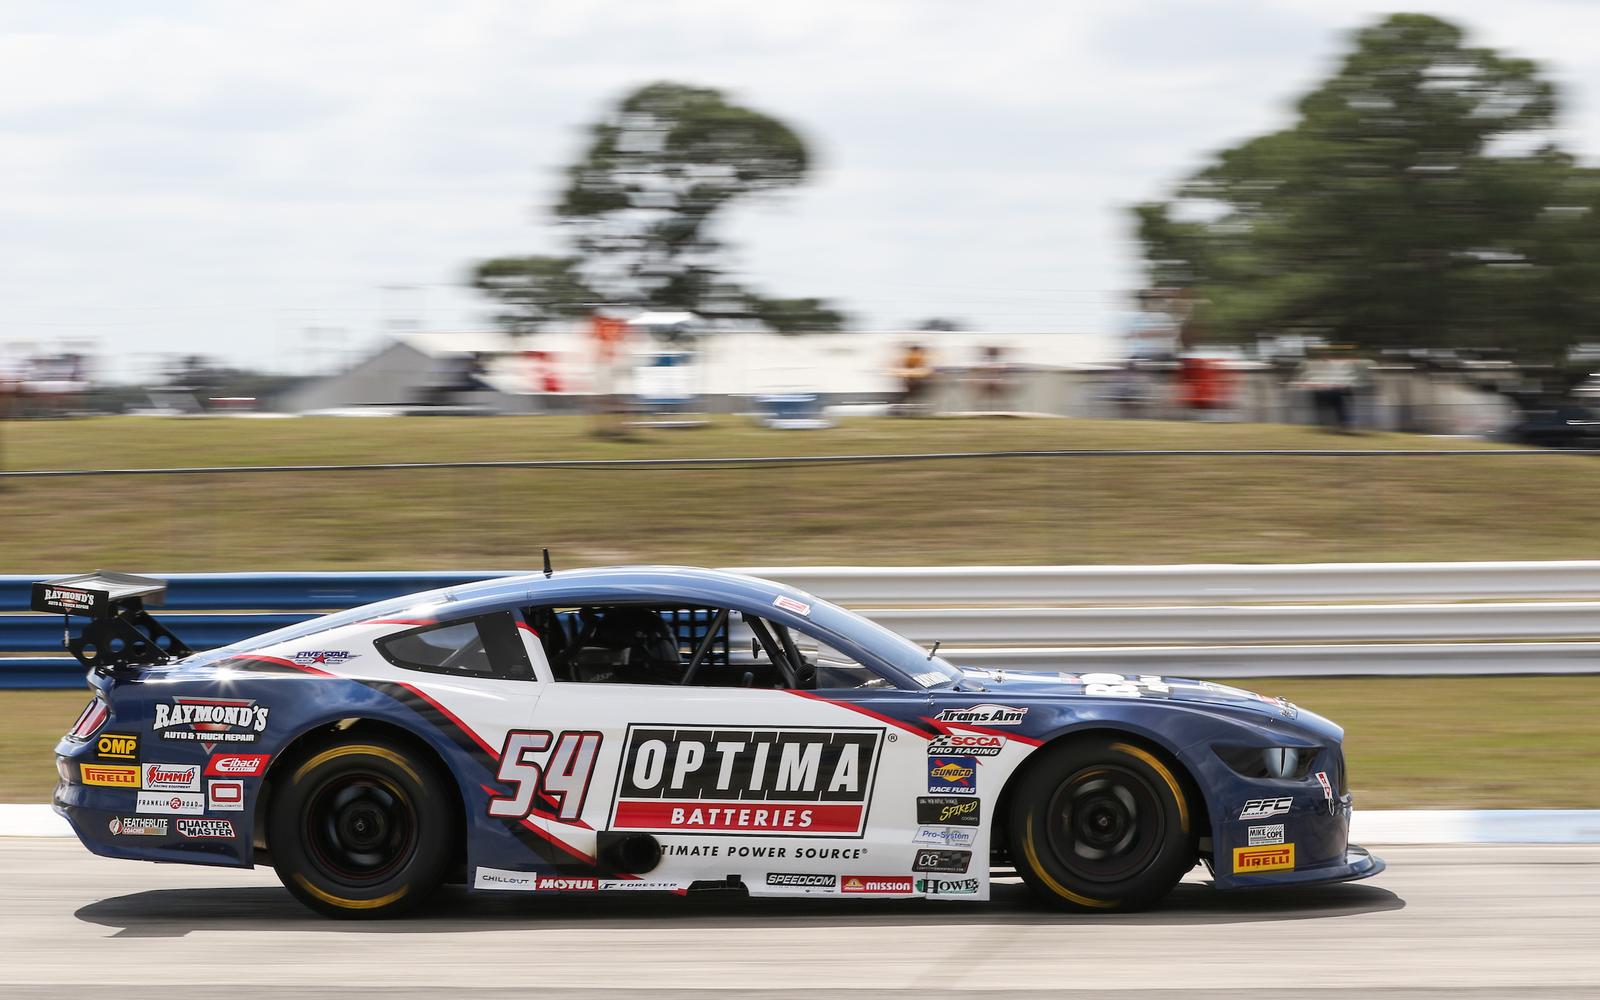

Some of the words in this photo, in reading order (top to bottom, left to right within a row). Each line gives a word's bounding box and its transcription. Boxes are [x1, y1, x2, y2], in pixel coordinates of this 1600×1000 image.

[44, 589, 95, 605] RAYMOND'S
[153, 704, 269, 732] RAYMOND'S
[944, 710, 989, 720] Trans
[990, 710, 1021, 720] Am
[196, 732, 224, 740] TRUCK
[224, 733, 255, 741] REPAIR
[951, 736, 1001, 746] SCCA
[98, 738, 136, 754] OMP
[929, 747, 952, 755] PRO
[955, 747, 999, 755] RACING
[215, 758, 260, 772] Eibach
[632, 739, 860, 793] OPTIMA
[85, 768, 136, 783] PIRELLI
[487, 729, 604, 822] 54
[932, 769, 972, 777] SUNOCO
[1243, 798, 1291, 812] PFC
[940, 801, 977, 821] SPIKED
[124, 819, 168, 828] FEATHERLITE
[671, 808, 814, 828] BATTERIES
[177, 820, 230, 831] QUARTER
[187, 828, 233, 837] MASTER
[923, 830, 969, 840] Pro-System
[1249, 829, 1266, 837] MIKE
[1266, 831, 1283, 839] COPE
[660, 845, 719, 857] TIMATE
[727, 846, 786, 858] POWER
[919, 854, 939, 866] CG
[1238, 849, 1290, 868] PIRELLI
[482, 875, 529, 884] CHILLOUT
[539, 879, 595, 890] MOTUL
[767, 875, 834, 886] SPEEDCOM
